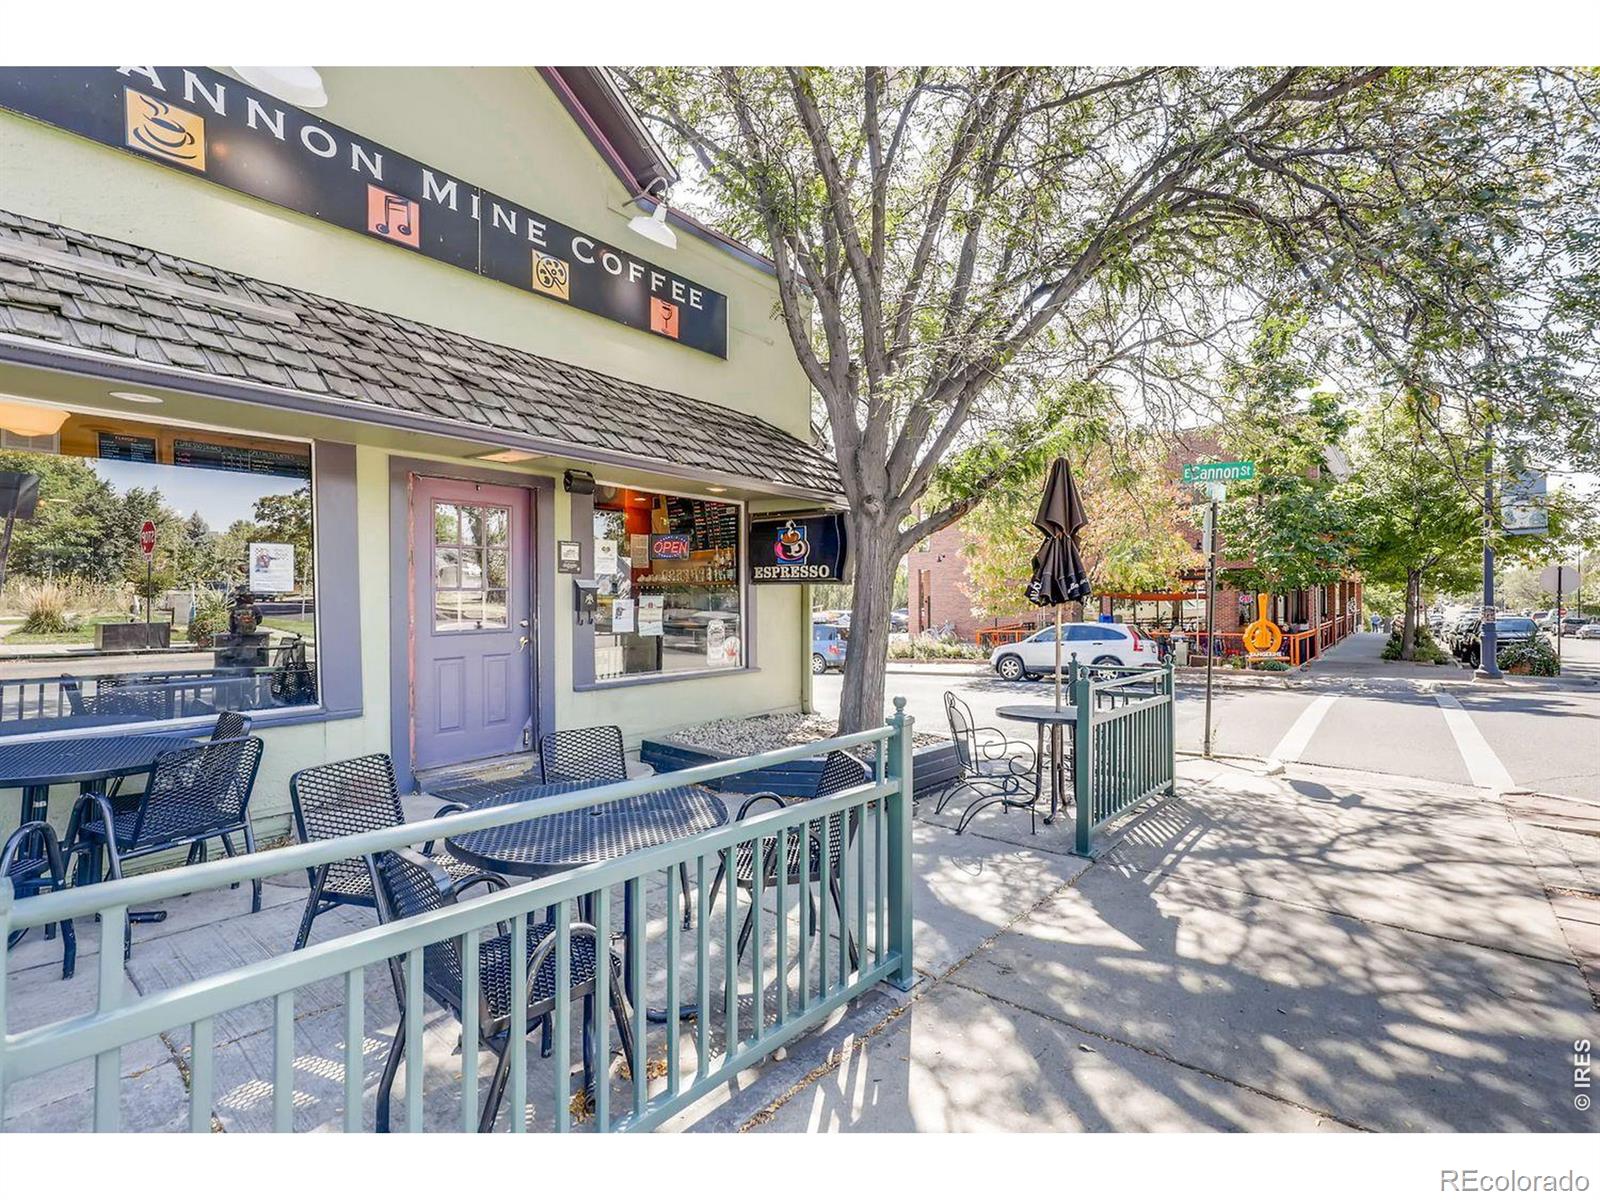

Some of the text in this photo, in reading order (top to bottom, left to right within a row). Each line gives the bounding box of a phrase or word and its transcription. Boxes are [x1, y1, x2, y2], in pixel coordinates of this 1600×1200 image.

[421, 168, 547, 247] MINE
[571, 236, 704, 310] COFFEE
[1184, 465, 1251, 480] E Cannon St
[653, 541, 688, 554] OPEN
[753, 565, 830, 579] ESPRESSO
